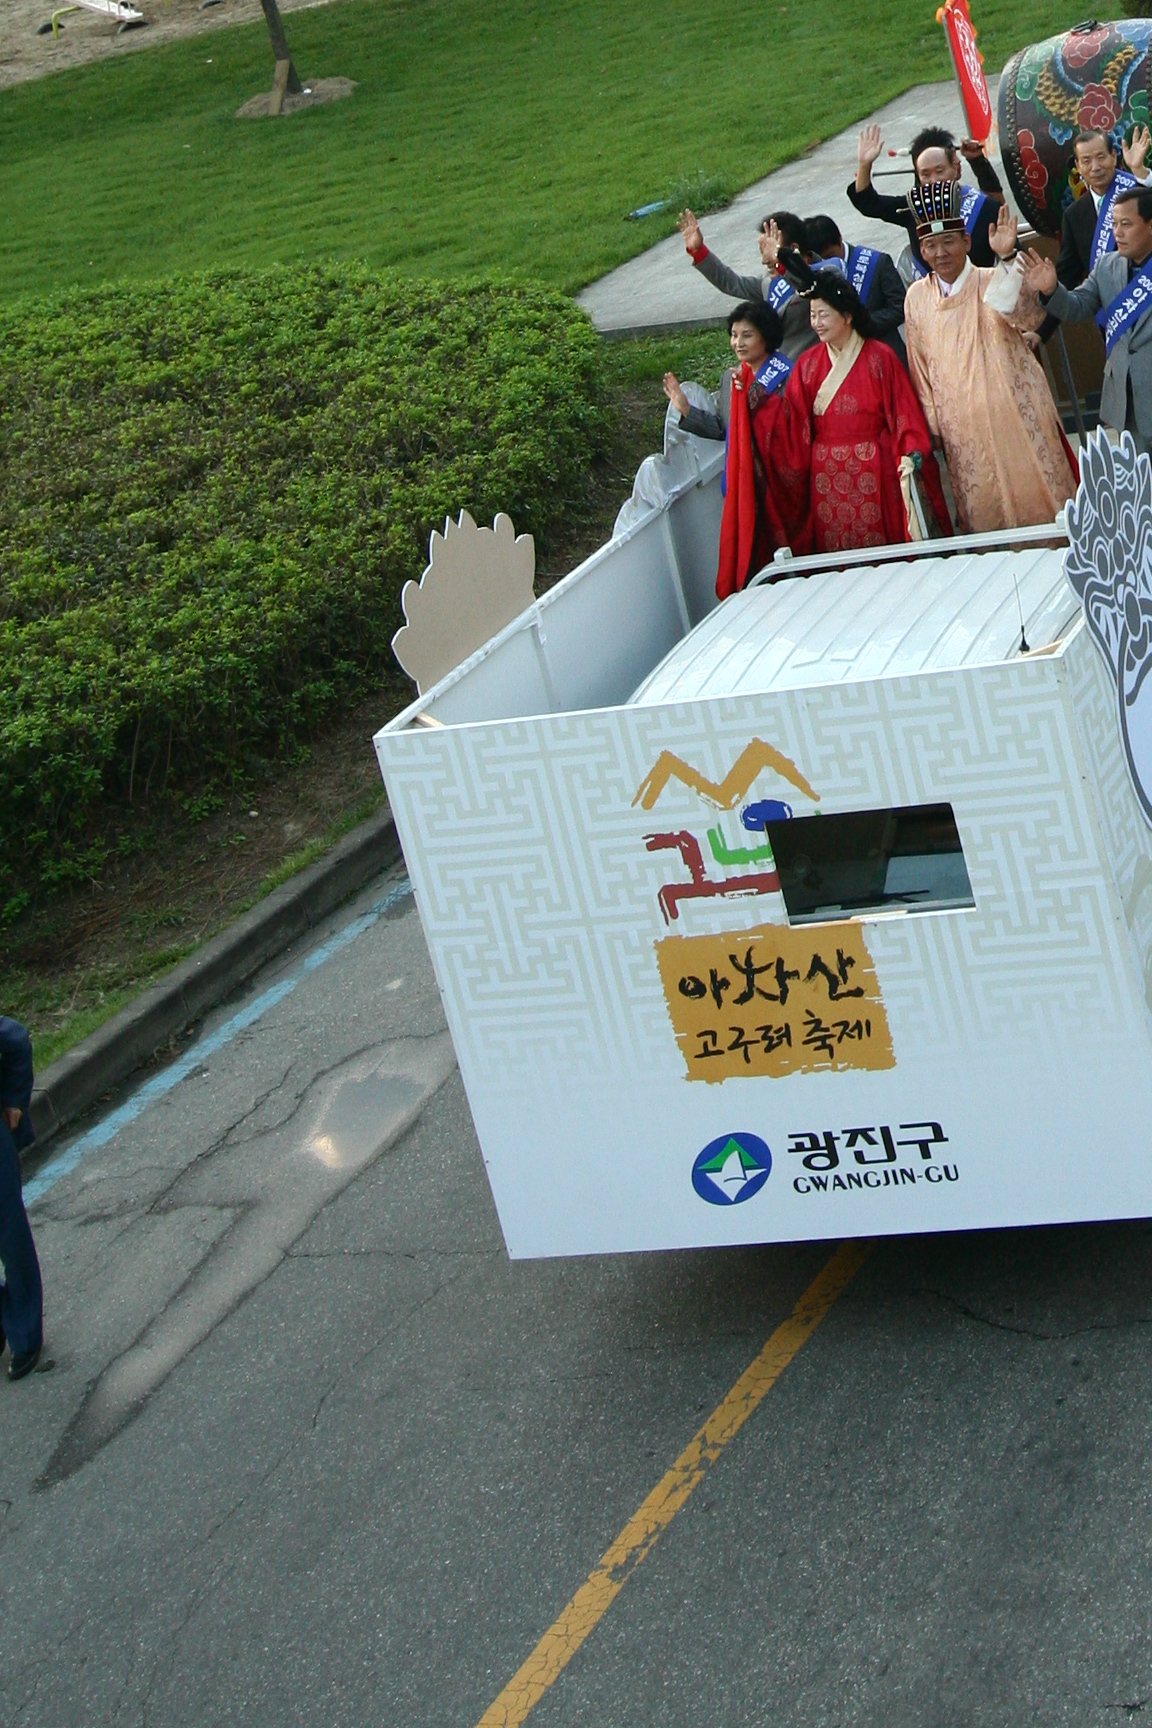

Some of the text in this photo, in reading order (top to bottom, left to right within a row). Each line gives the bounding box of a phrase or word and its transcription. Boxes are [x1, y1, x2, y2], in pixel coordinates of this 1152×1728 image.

[1114, 174, 1136, 188] 2007
[769, 357, 790, 373] 2007
[678, 945, 865, 1010] 아차산
[693, 1008, 872, 1064] 고구려 축제
[786, 1121, 949, 1172] 광진구
[792, 1162, 960, 1195] GWANGJIN-GU
